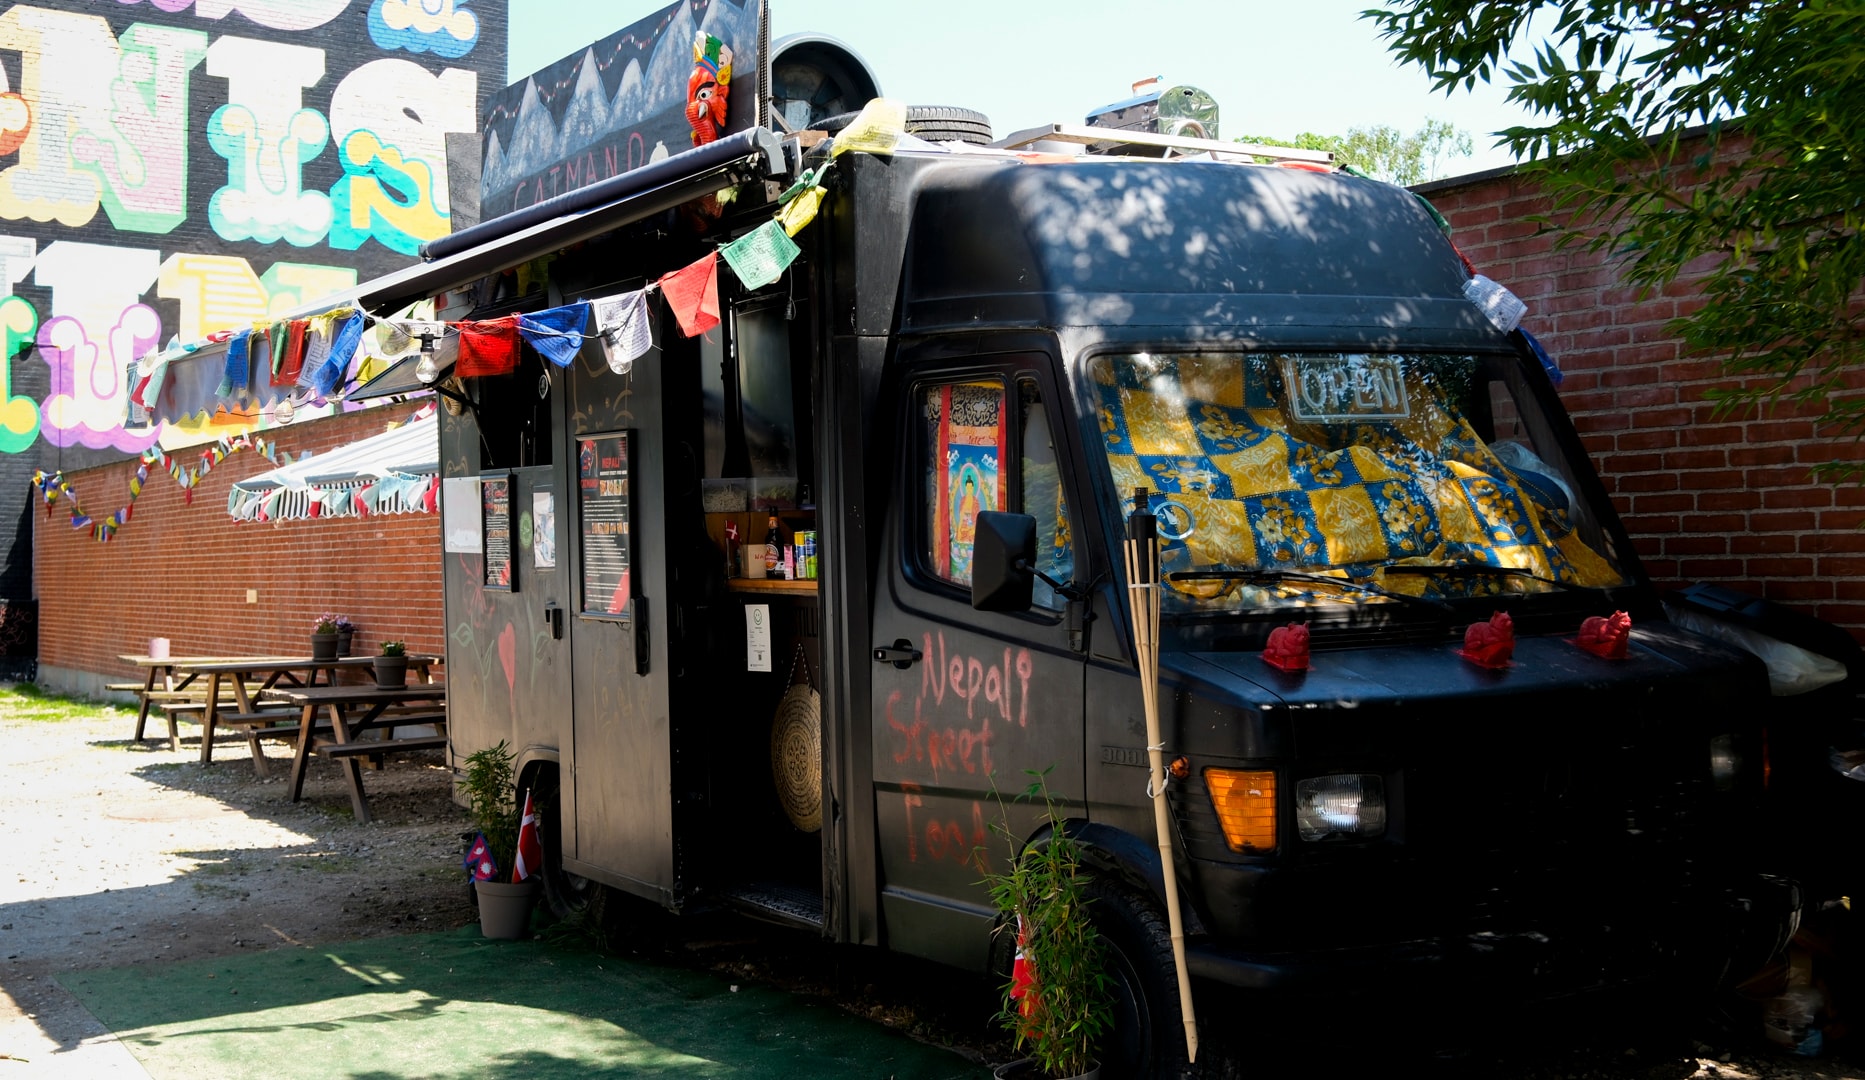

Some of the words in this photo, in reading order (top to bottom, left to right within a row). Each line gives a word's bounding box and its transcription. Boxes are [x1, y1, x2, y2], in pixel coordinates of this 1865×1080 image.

[1301, 368, 1399, 409] OPEN
[921, 628, 1033, 728] Nepali
[886, 689, 993, 780] Street
